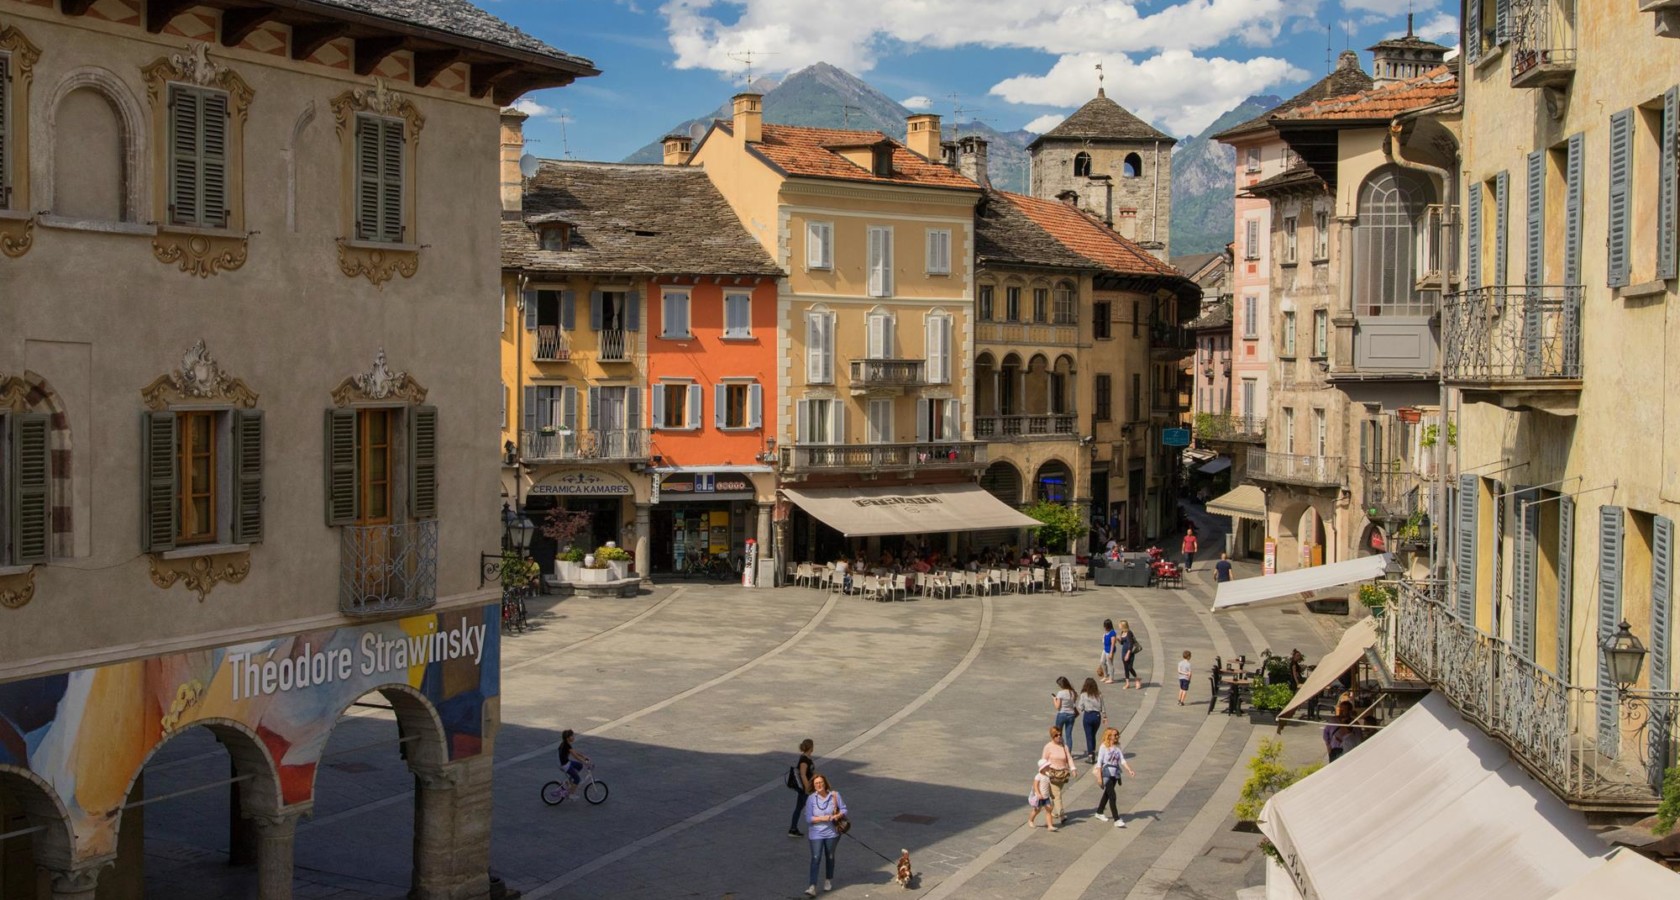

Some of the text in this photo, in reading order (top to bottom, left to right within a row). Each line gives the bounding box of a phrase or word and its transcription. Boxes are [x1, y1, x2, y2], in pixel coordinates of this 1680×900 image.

[533, 485, 629, 493] CERAMICA KAMARES
[229, 617, 486, 700] Théodore Strawinsky
